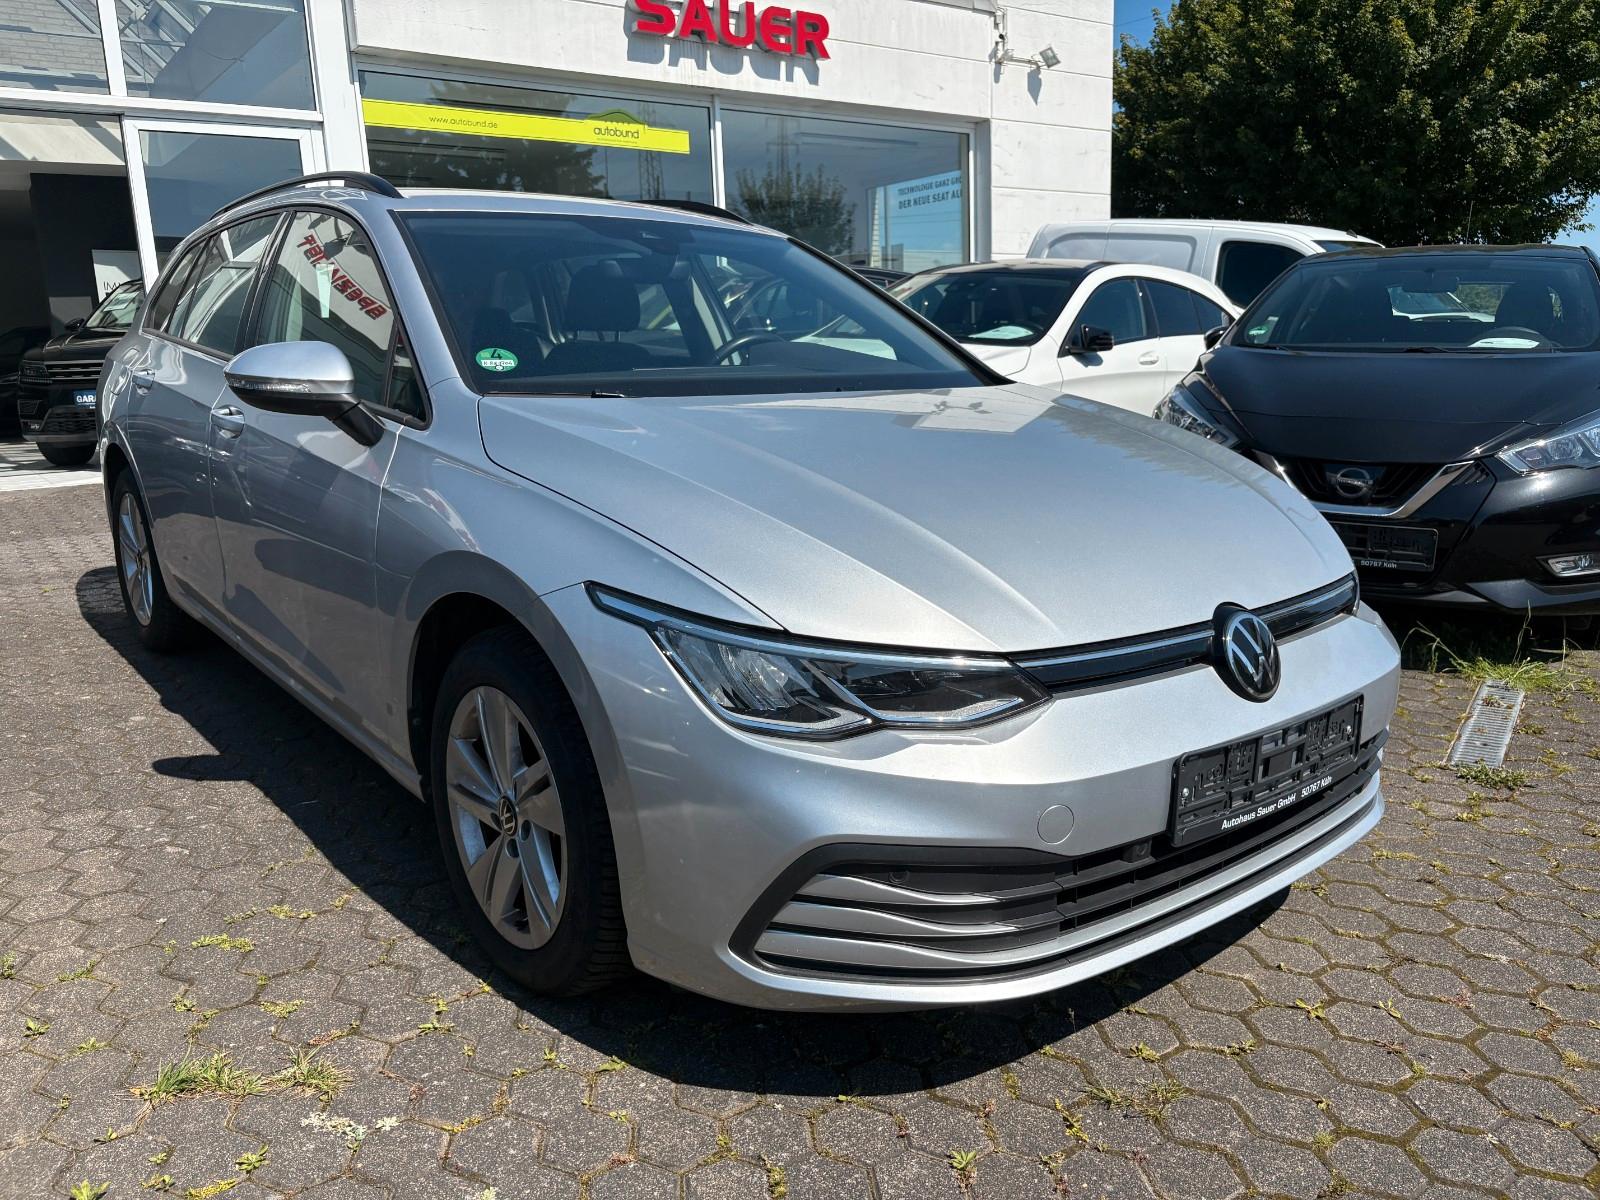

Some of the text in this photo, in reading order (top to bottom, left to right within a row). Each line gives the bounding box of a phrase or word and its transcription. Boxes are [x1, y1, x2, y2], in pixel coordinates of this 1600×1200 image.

[636, 0, 831, 59] SAUER
[429, 116, 498, 129] www.autobund.de
[593, 126, 640, 139] autobund
[932, 192, 949, 203] SEAT
[491, 349, 502, 359] 4
[1221, 811, 1256, 830] Autohaus
[1256, 803, 1277, 817] Sauer
[1277, 793, 1297, 809] GmbH
[1301, 780, 1321, 798] 50767
